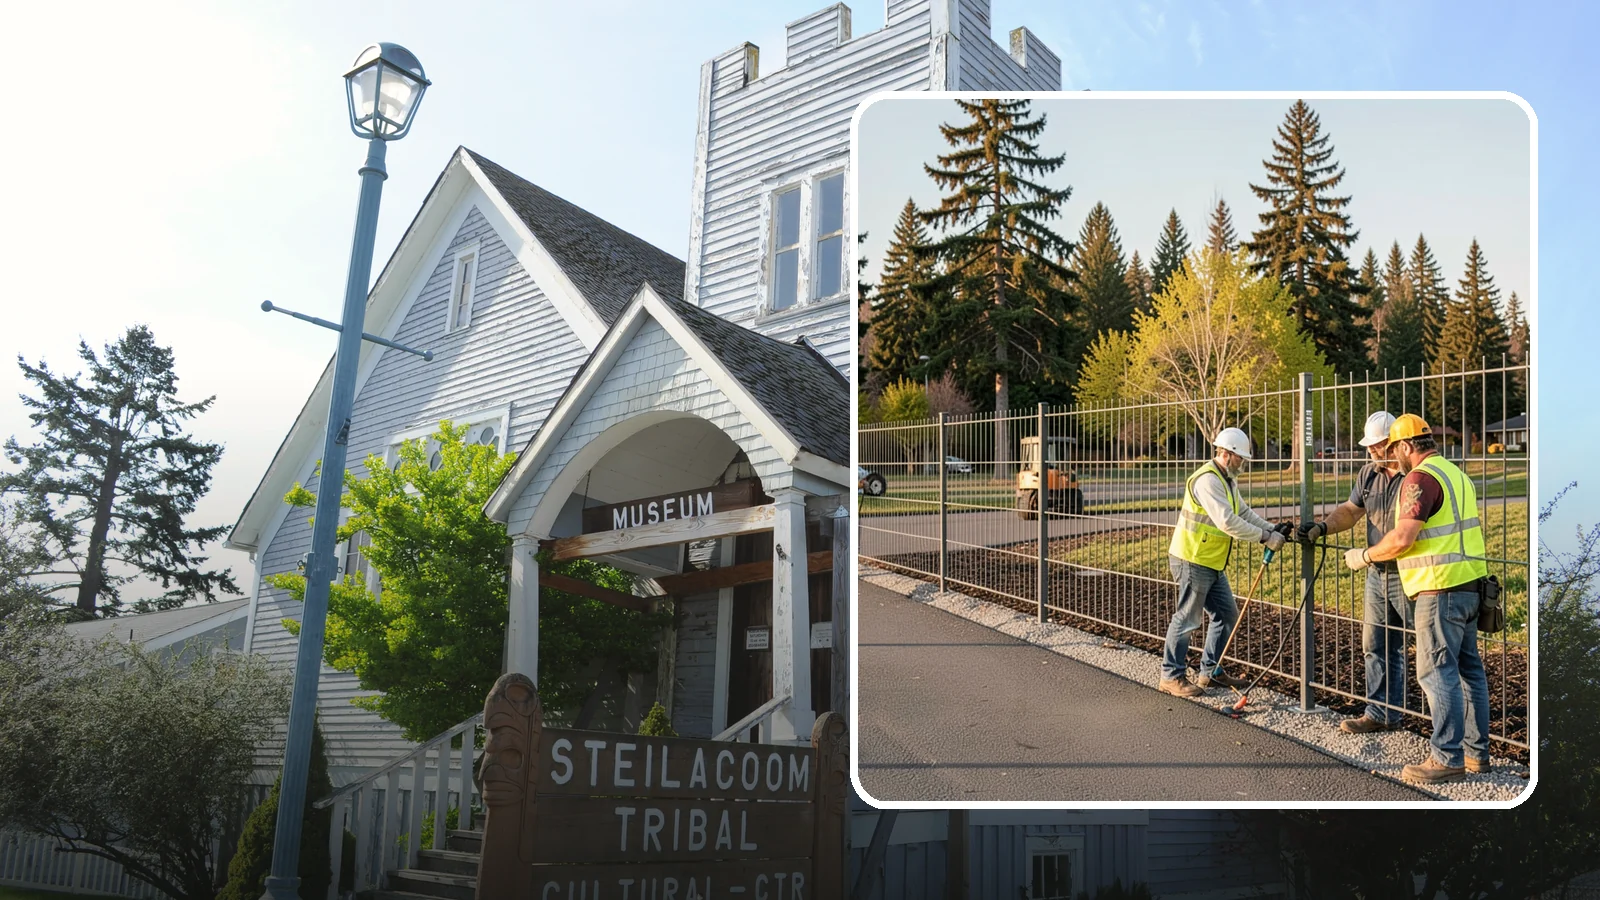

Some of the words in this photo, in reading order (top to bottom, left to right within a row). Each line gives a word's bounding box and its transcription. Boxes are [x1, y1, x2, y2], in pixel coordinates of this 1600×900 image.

[613, 491, 714, 531] MUSEUM
[550, 738, 810, 792] STEILACOOM
[615, 806, 758, 852] TRIBAL
